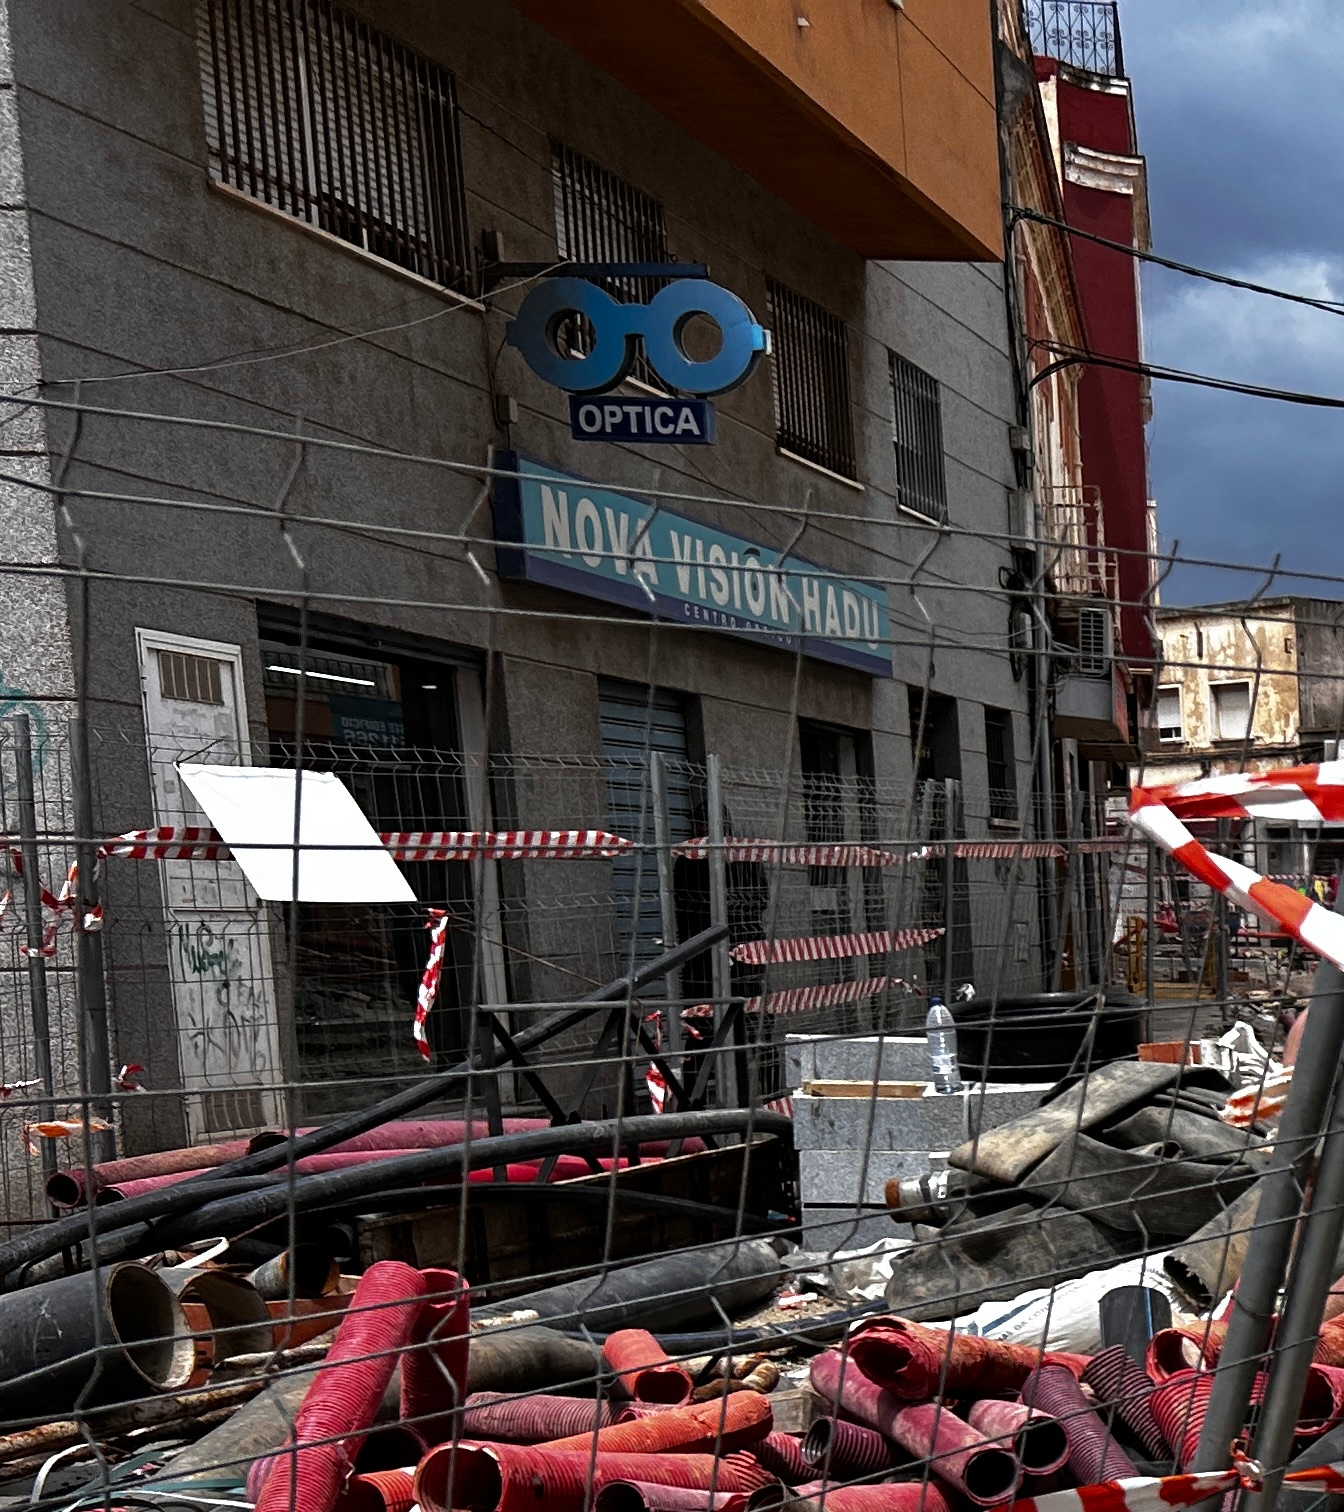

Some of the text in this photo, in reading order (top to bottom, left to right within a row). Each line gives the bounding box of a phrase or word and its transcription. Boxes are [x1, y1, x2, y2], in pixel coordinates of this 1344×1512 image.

[578, 404, 701, 436] OPTICA
[540, 484, 659, 586] NOVA
[801, 575, 881, 652] HADU
[683, 602, 737, 629] CENTRO
